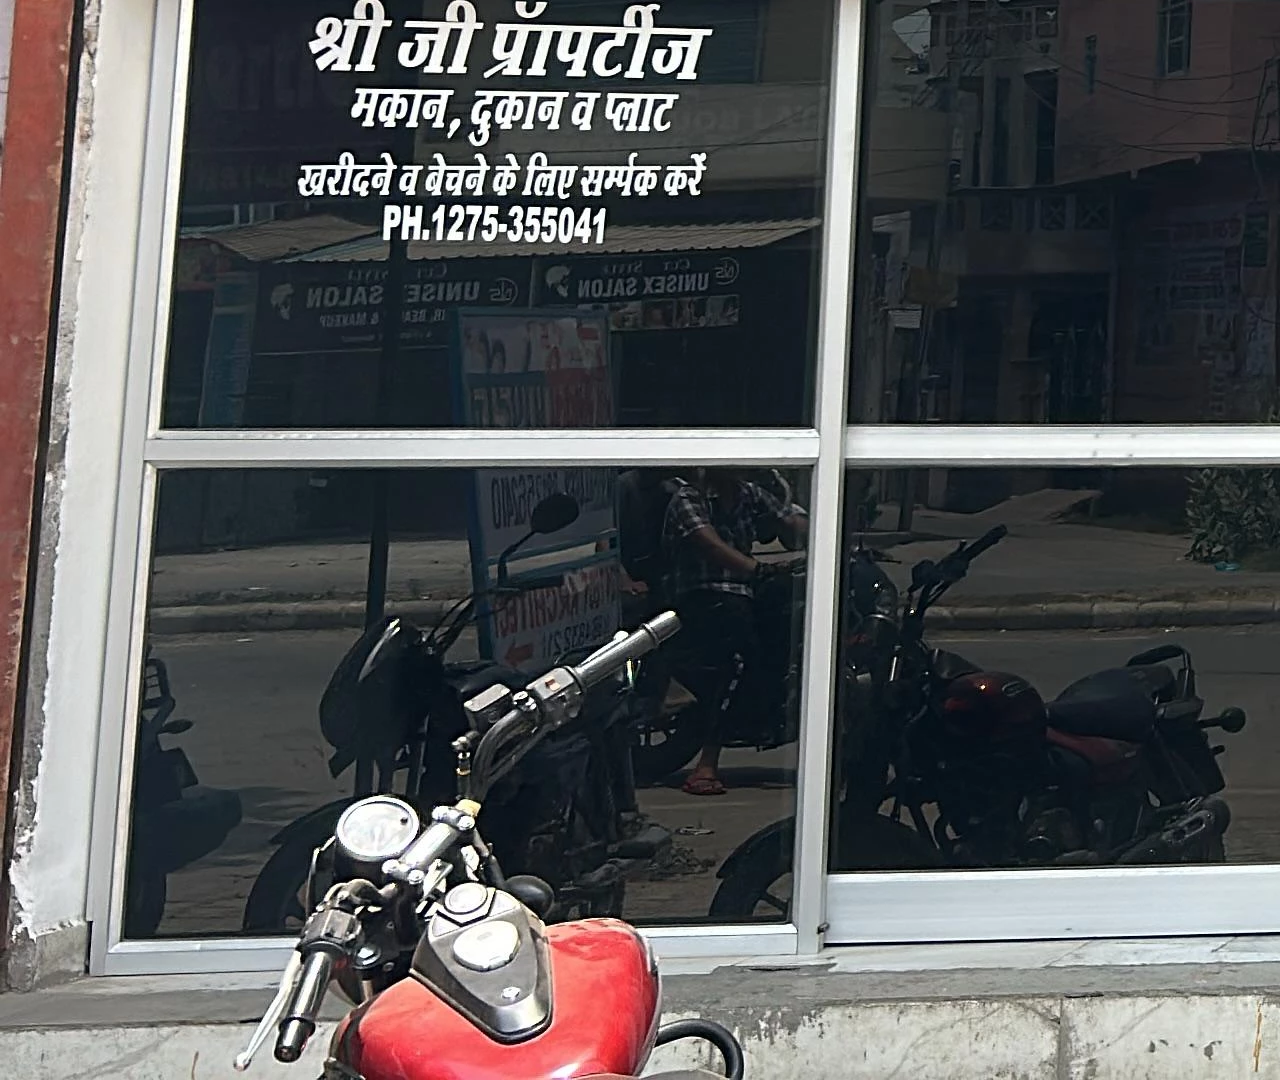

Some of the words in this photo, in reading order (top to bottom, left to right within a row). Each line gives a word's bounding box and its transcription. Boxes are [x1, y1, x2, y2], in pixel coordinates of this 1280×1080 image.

[397, 0, 485, 74] जी
[350, 87, 462, 139] मकान,
[468, 90, 570, 147] दुकान
[571, 91, 602, 131] व
[604, 92, 680, 132] प्लाट
[297, 151, 398, 197] खरीदने
[398, 165, 424, 196] व
[425, 152, 491, 196] बेचने
[492, 153, 521, 196] के
[521, 151, 579, 200] लिए
[663, 152, 707, 196] करें
[382, 204, 607, 244] PH.1275-355041
